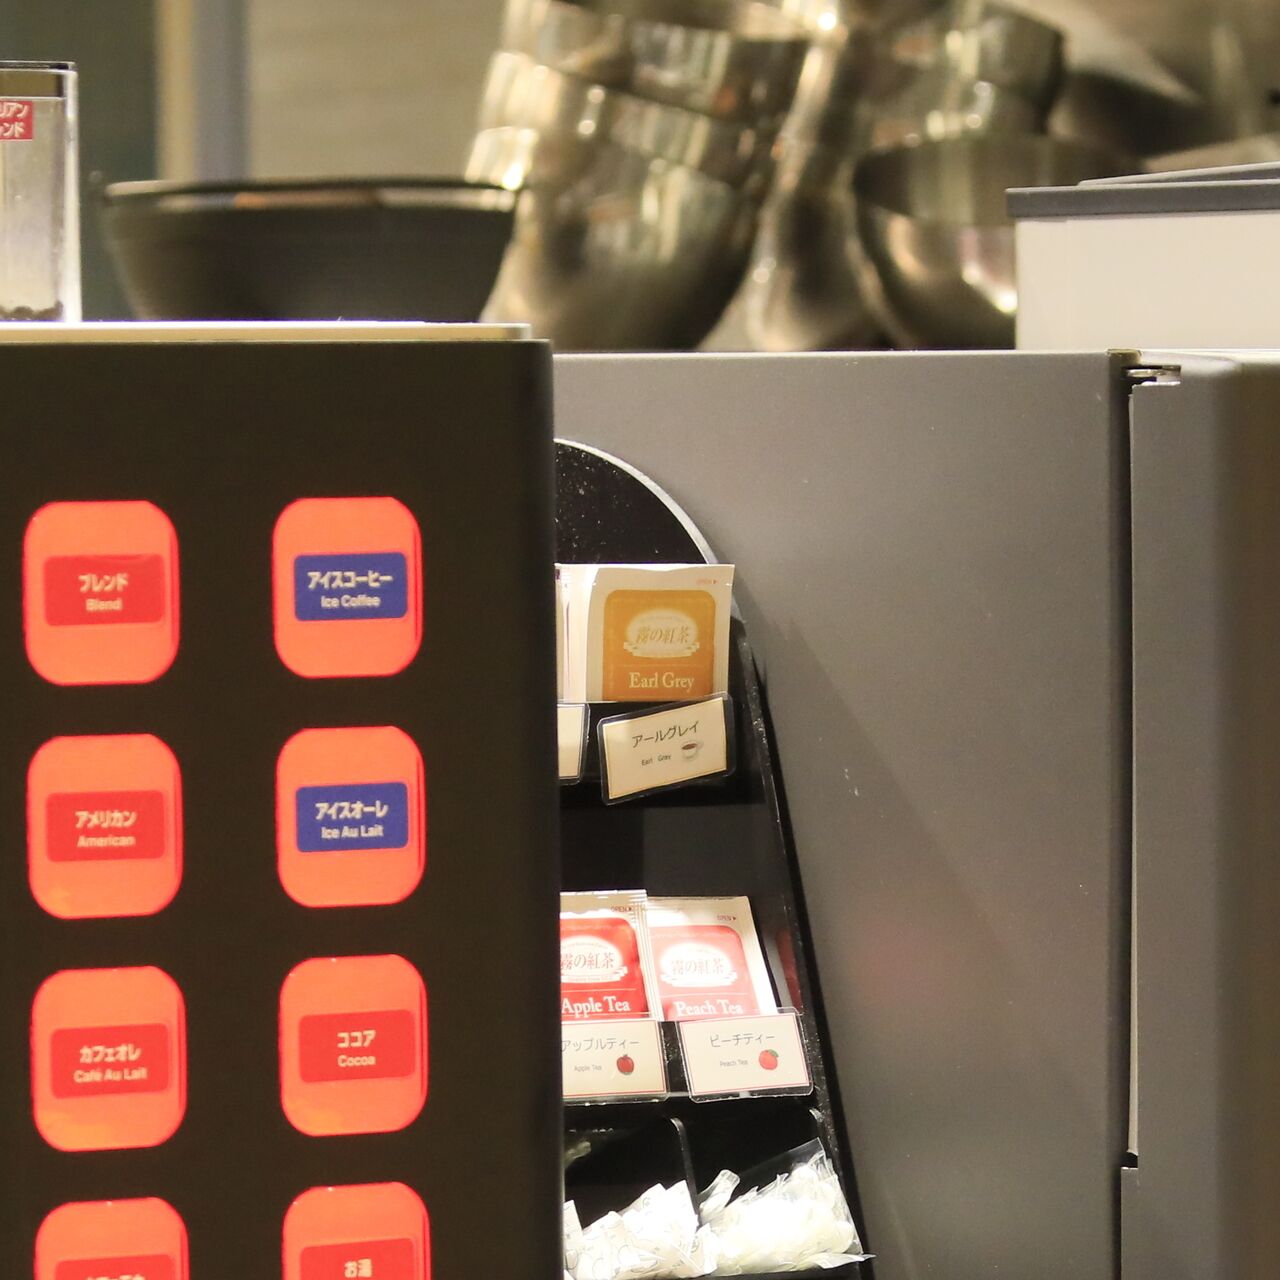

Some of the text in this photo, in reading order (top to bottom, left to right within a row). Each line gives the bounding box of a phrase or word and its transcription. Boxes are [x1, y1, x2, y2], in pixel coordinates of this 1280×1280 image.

[78, 573, 129, 593] ブレンド
[307, 570, 393, 590] アイスコーヒー
[86, 598, 123, 611] Blend
[321, 594, 382, 609] Ice Coffee
[629, 671, 695, 693] Earl Grey
[632, 719, 700, 748] アールグレイ
[75, 810, 137, 829] アメリカン
[315, 801, 389, 820] アイスオーレ
[77, 834, 136, 848] American
[321, 824, 384, 839] Ice Au Lait
[561, 996, 631, 1018] Apple Tea
[675, 999, 744, 1018] Peach Tea
[337, 1030, 377, 1048] ココア
[561, 1037, 640, 1052] アップルティー
[709, 1033, 776, 1048] ピーチティー
[80, 1043, 142, 1064] カフェオレ
[337, 1053, 376, 1067] Cocoa
[103, 1068, 122, 1082] Au
[123, 1066, 148, 1080] Lait
[344, 1258, 372, 1278] お湯
